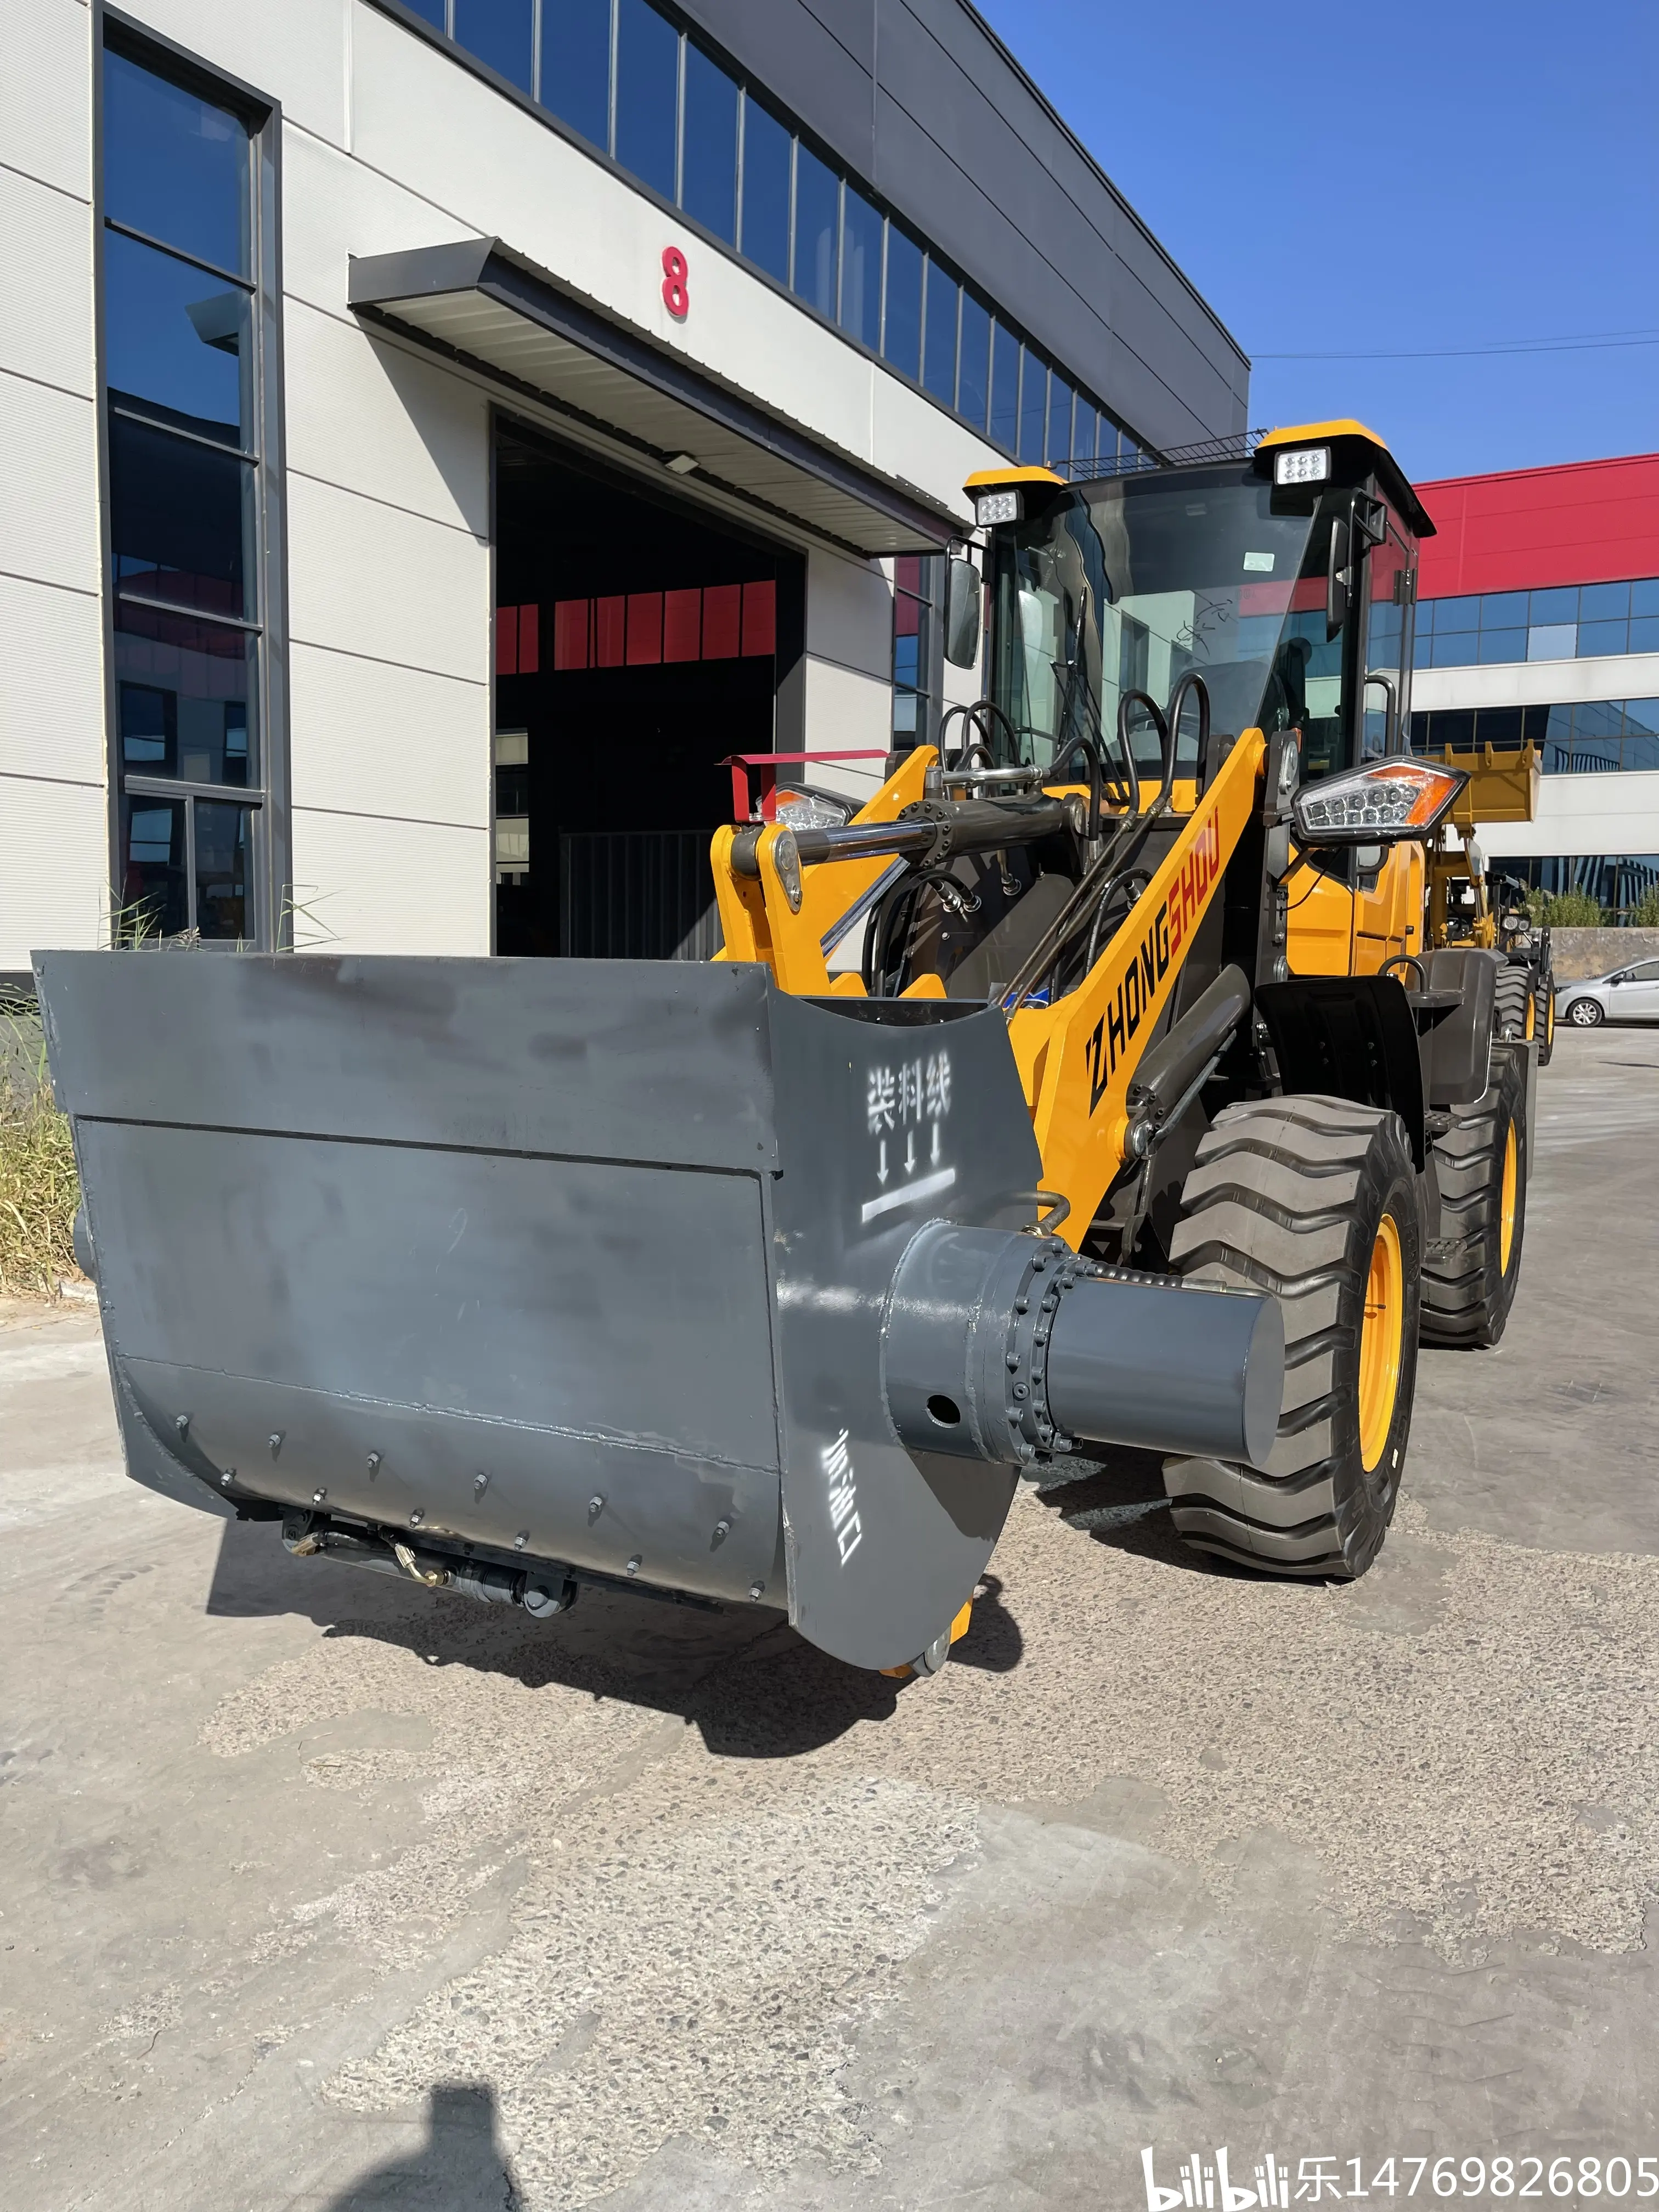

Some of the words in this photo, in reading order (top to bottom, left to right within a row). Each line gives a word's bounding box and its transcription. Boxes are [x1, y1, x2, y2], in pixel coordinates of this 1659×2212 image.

[662, 245, 690, 316] 8
[1085, 805, 1220, 1120] ZHONGSHOU
[867, 1051, 951, 1135] 装料线
